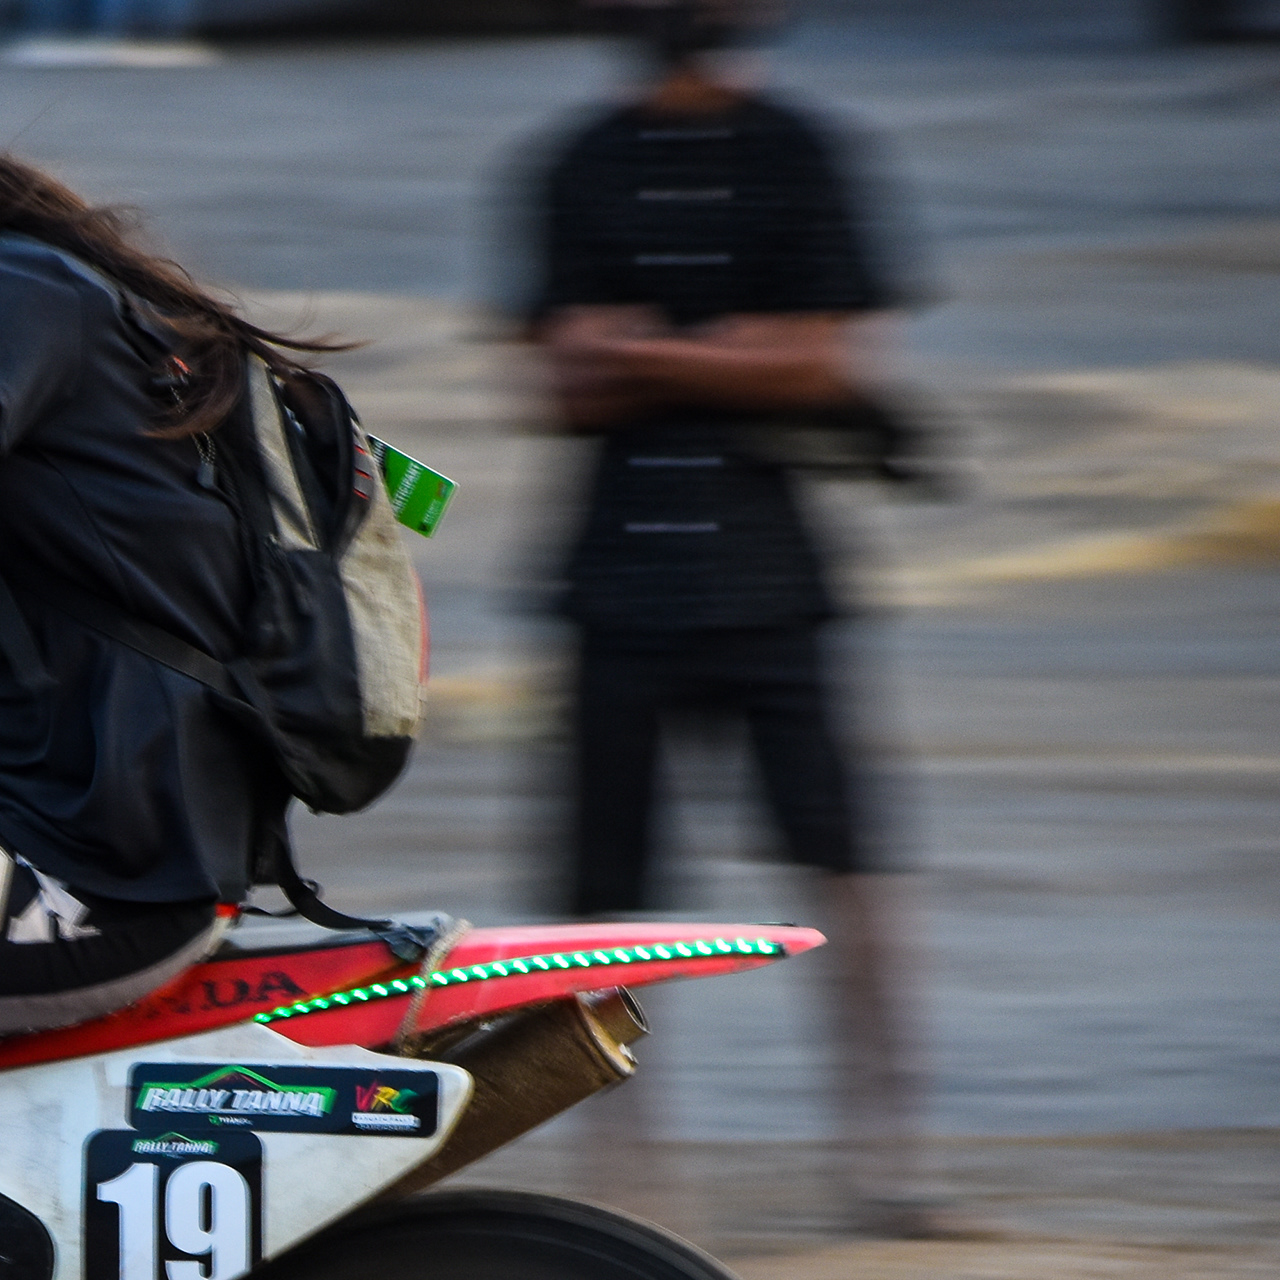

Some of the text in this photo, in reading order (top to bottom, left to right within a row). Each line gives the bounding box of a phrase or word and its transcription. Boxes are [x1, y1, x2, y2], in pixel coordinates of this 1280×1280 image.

[141, 1087, 325, 1117] RALLY TANNA
[134, 1141, 212, 1155] RALLY TANNA
